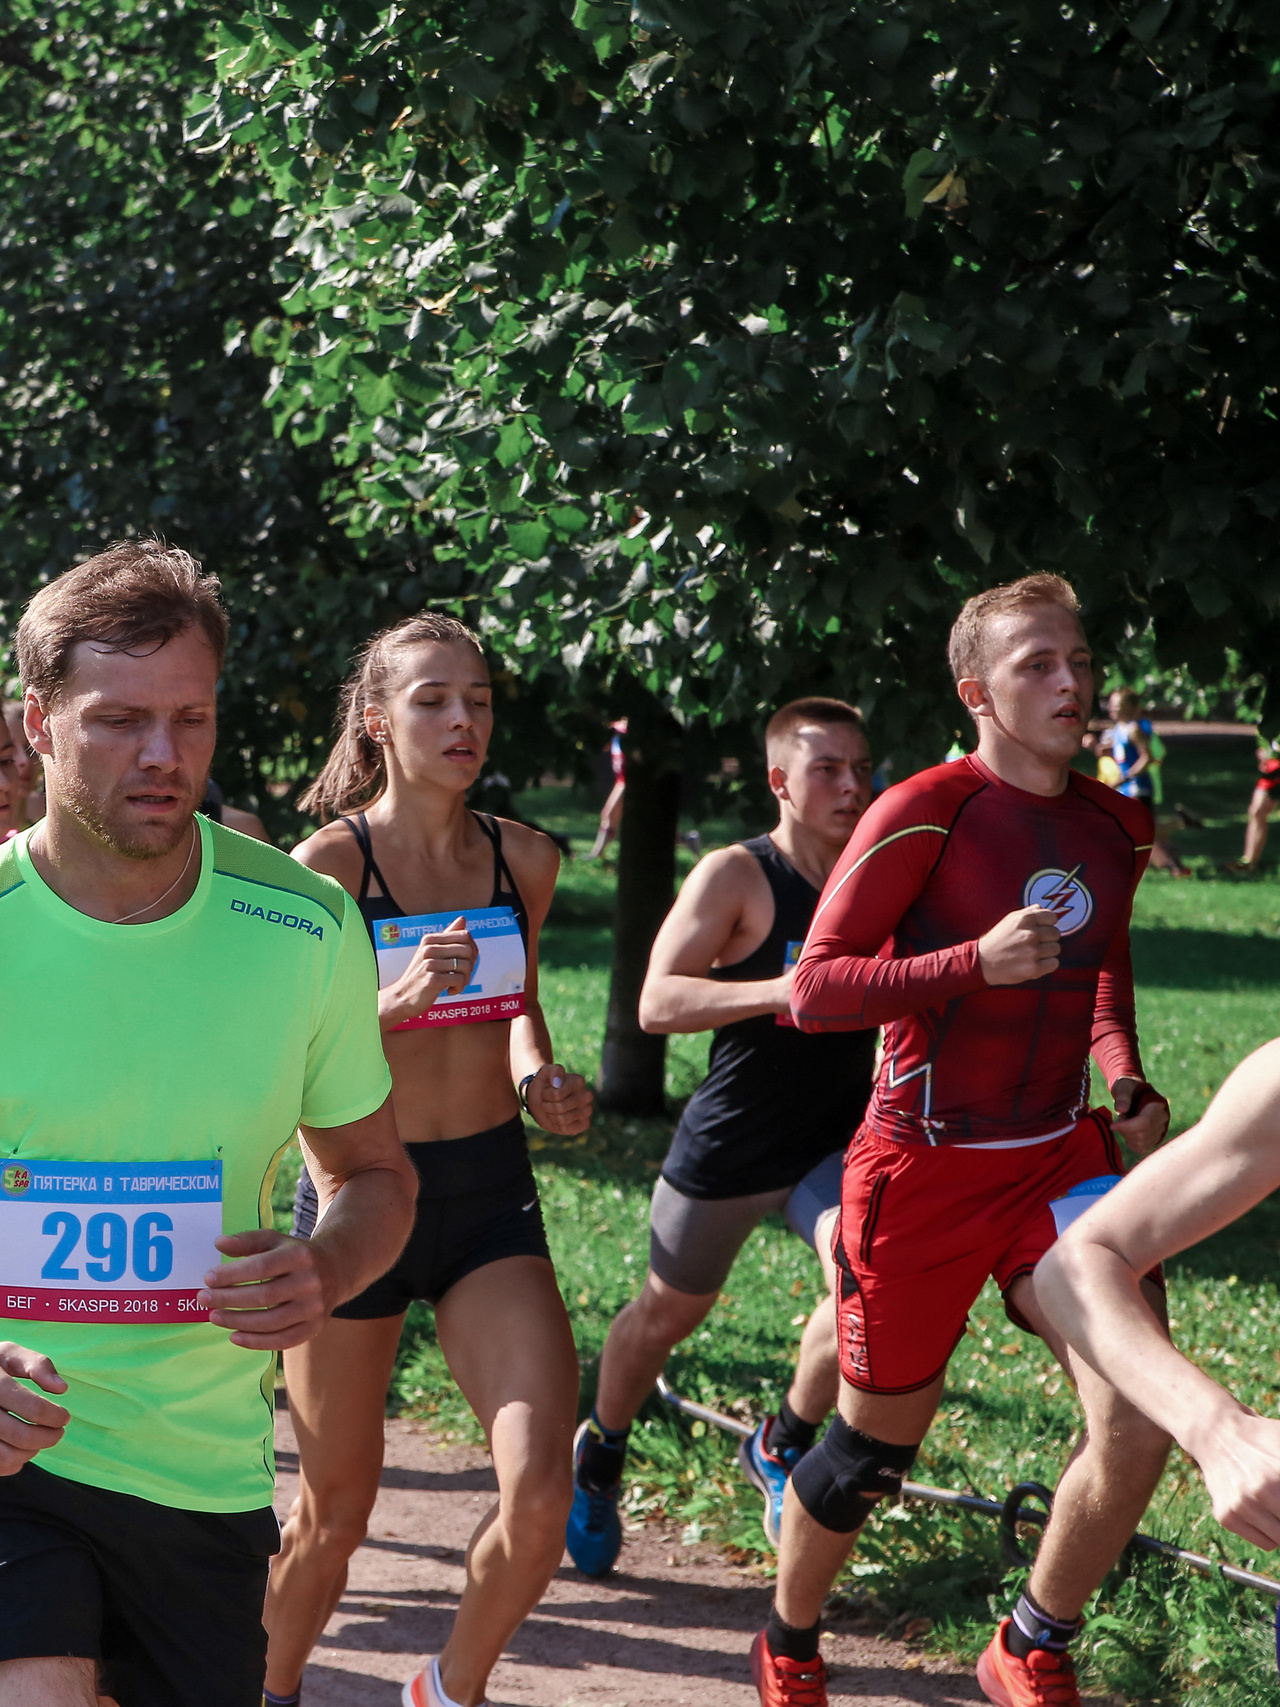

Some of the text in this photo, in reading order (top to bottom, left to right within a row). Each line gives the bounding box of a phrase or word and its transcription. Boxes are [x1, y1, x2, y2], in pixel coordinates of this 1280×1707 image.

[230, 899, 324, 941] DIADORA
[428, 1000, 520, 1021] 5KASPB 2018 5KM
[33, 1174, 219, 1192] ПЯТЕРКА В ТАВРИЧЕСКОМ
[41, 1211, 173, 1283] 296
[7, 1295, 36, 1309] БЕГ
[58, 1299, 119, 1313] 5KASPB
[123, 1299, 159, 1313] 2018
